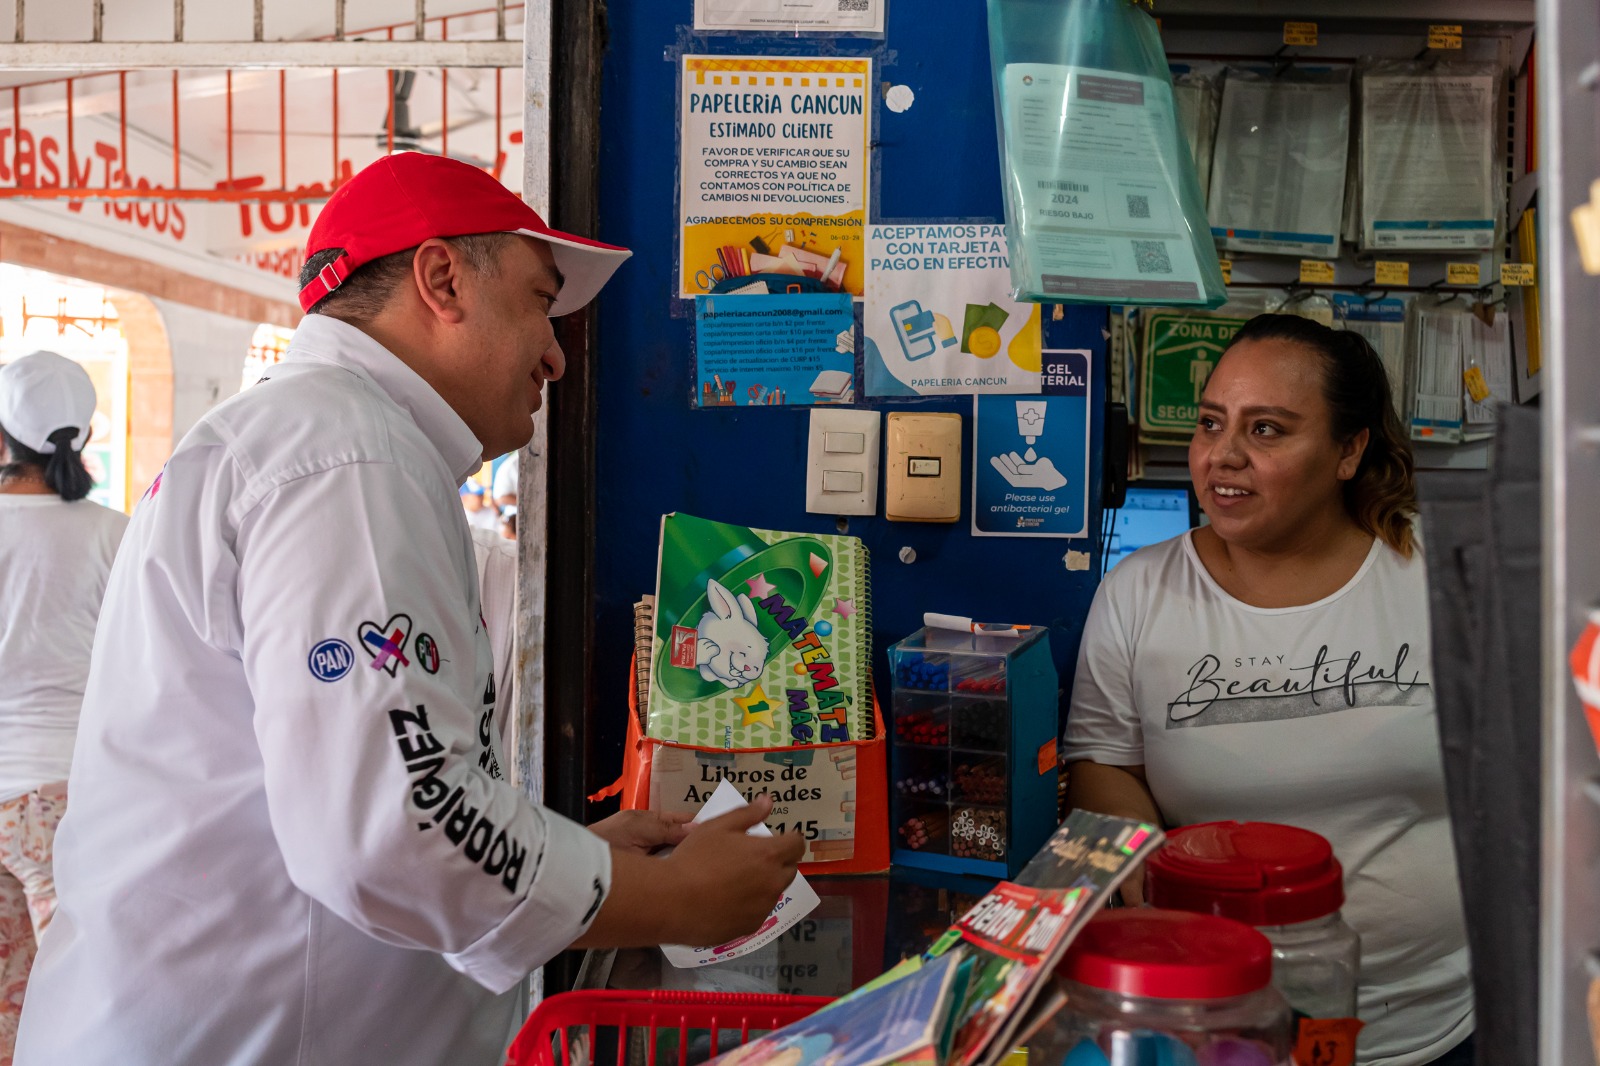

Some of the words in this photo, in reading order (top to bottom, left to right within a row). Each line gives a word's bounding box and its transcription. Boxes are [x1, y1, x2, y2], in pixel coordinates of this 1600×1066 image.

[791, 94, 862, 115] CANCUN
[702, 148, 738, 156] FAVOR
[740, 148, 754, 156] DE
[756, 148, 810, 157] VERIFICAR
[812, 148, 834, 158] QUE
[836, 149, 850, 158] SU
[704, 159, 750, 168] COMPRA
[752, 160, 758, 168] Y
[760, 160, 774, 168] SU
[776, 160, 818, 168] CAMBIO
[820, 160, 848, 169] SEAN
[714, 171, 778, 179] CORRECTOS
[780, 171, 794, 180] YA
[796, 172, 818, 180] QUE
[820, 172, 836, 180] NO
[95, 141, 186, 240] Tacos
[700, 182, 760, 190] CONTAMOS
[762, 182, 785, 191] CON
[788, 181, 834, 192] POLÍTICA
[838, 184, 851, 192] DE
[702, 194, 749, 202] CAMBIOS
[751, 194, 761, 202] NI
[1051, 194, 1079, 205] 2024
[1039, 208, 1071, 218] RIESGO
[1073, 210, 1094, 220] BAJO
[685, 216, 766, 225] AGRADECEMOS
[872, 226, 977, 240] ACEPTAMOS
[886, 242, 924, 255] CON
[928, 241, 1001, 254] TARJETA
[871, 258, 920, 270] PAGO
[924, 258, 944, 270] EN
[1169, 324, 1213, 340] ZONA
[1047, 364, 1072, 375] GEL
[911, 378, 963, 387] PAPELERIA
[965, 377, 1008, 386] CANCUN
[1004, 493, 1036, 502] Please
[1038, 494, 1056, 502] use
[990, 504, 1052, 513] antibacterial
[1054, 505, 1070, 515] gel
[316, 646, 348, 675] PAN
[1234, 655, 1285, 668] STAY
[1169, 643, 1420, 722] Beautiful
[747, 700, 770, 714] 1
[701, 764, 774, 784] Libros
[780, 766, 808, 780] de
